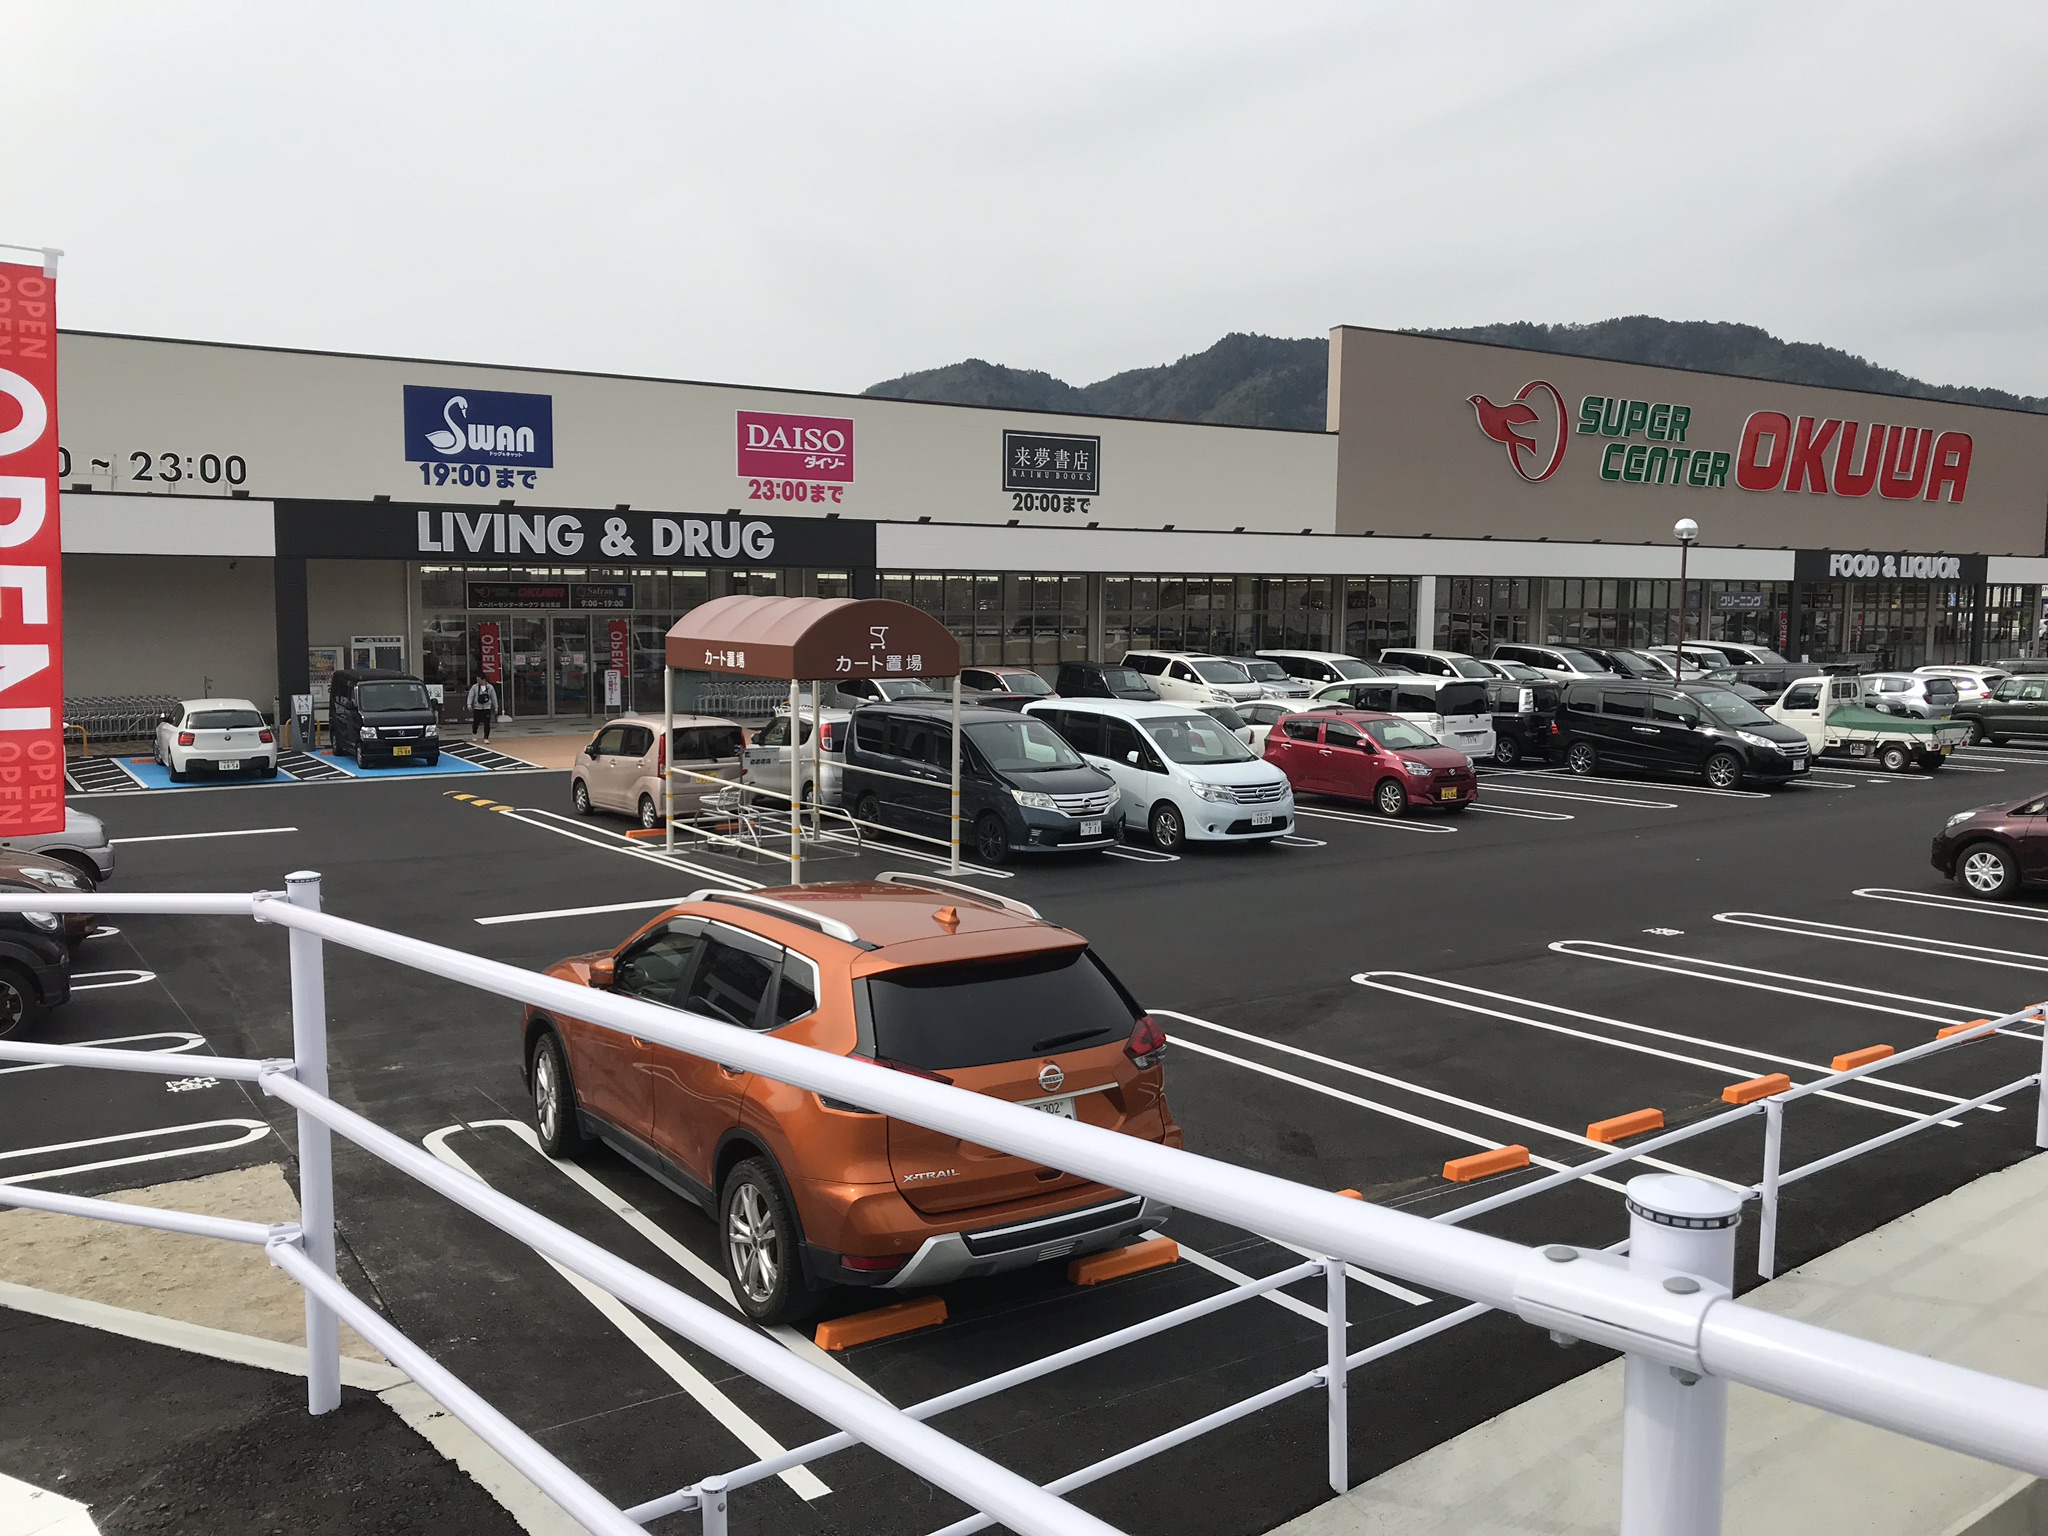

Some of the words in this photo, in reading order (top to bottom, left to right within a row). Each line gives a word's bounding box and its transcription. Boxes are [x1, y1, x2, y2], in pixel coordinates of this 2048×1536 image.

[17, 276, 48, 359] OPEN
[425, 395, 535, 455] SWAN
[1575, 394, 1692, 443] SUPER
[746, 423, 845, 452] DAISO
[130, 451, 247, 485] 23:00
[804, 455, 845, 469] ダイソー
[1014, 446, 1089, 470] 来夢書店
[1600, 441, 1731, 488] CENTER
[1734, 410, 1974, 503] OKUWA
[1012, 469, 1050, 478] RAIMU
[1055, 472, 1091, 481] BOOKS
[417, 510, 584, 556] LIVING
[600, 517, 637, 557] &
[652, 518, 775, 560] DRUG
[1829, 553, 1880, 578] FOOD
[1882, 555, 1897, 578] &
[1900, 555, 1960, 580] LIQUOR
[1720, 595, 1762, 607] クリーニング
[1779, 618, 1788, 641] OPEN
[704, 649, 745, 669] カート置場
[836, 654, 923, 672] カート置場
[301, 715, 308, 724] P
[27, 740, 57, 824] OPEN
[1043, 1102, 1061, 1114] 302
[902, 1167, 961, 1184] X-TRAIL
